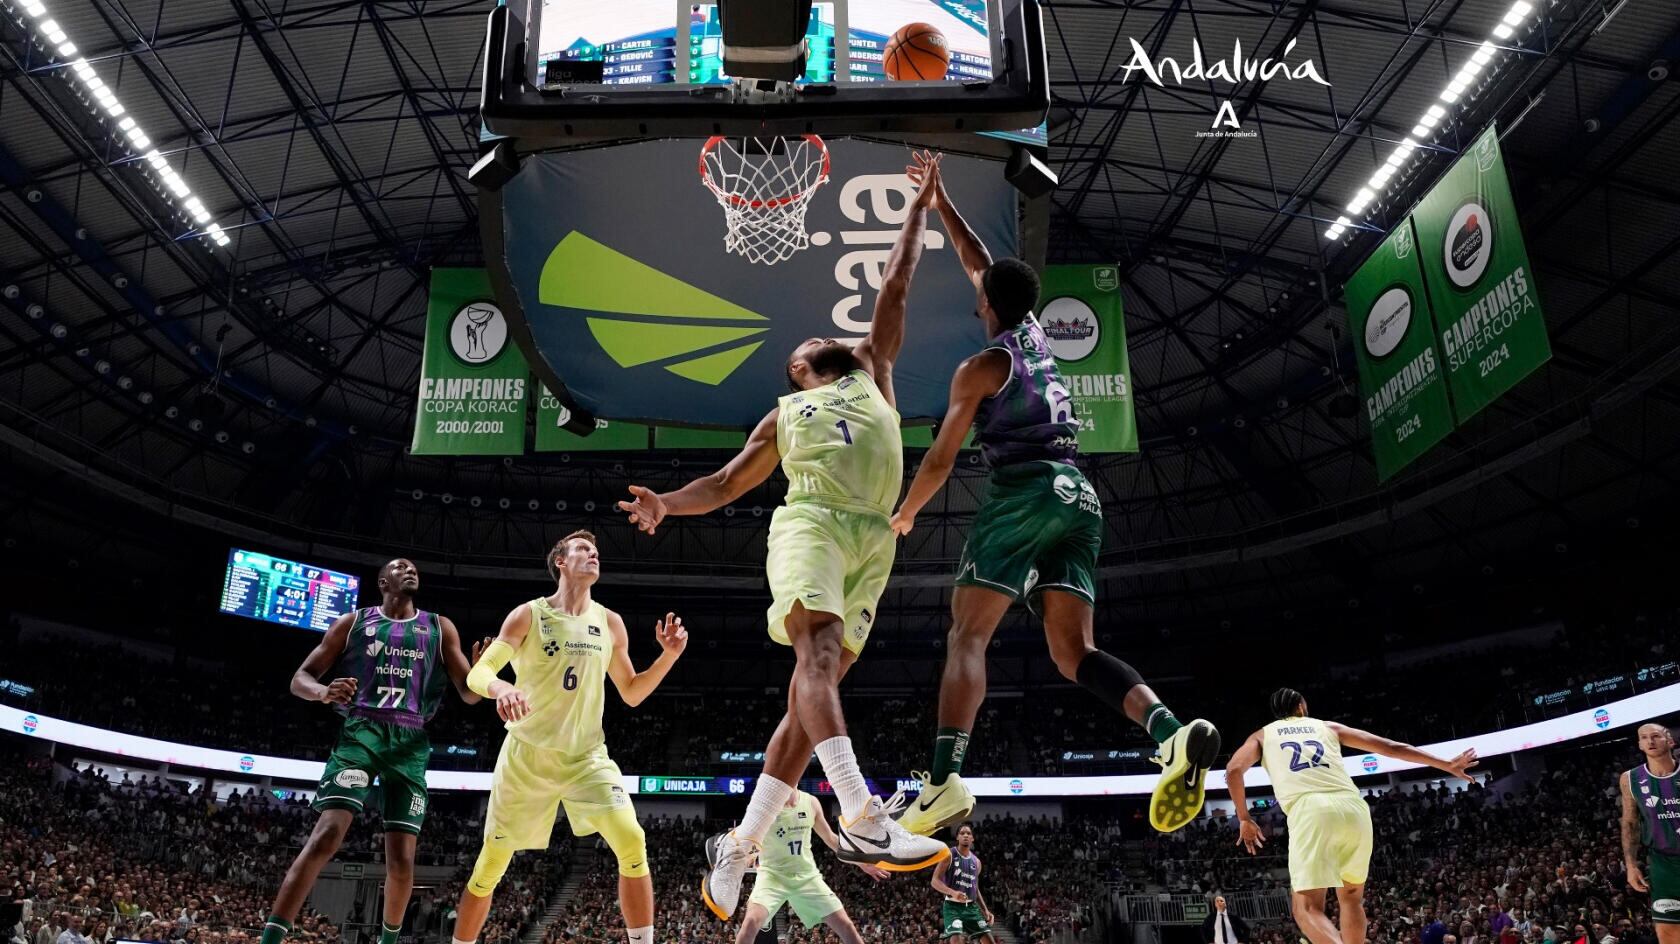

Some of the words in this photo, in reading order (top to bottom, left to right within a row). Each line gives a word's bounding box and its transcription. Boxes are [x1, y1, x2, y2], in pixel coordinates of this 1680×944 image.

[622, 40, 651, 50] CARTER
[603, 67, 612, 75] 33
[620, 65, 642, 73] TILLIE
[810, 174, 944, 347] caja
[1443, 266, 1528, 357] CAMPEONES
[1450, 294, 1535, 373] SUPERCOPA
[1479, 343, 1510, 378] 2024
[421, 378, 525, 400] CAMPEONES
[1063, 374, 1127, 396] PEONES
[1367, 346, 1436, 422] CAMPEONES
[425, 401, 465, 413] COPA
[468, 401, 518, 413] KORAC
[1074, 402, 1092, 414] CL
[436, 421, 504, 434] 2000/2001
[835, 420, 853, 445] 1
[1078, 419, 1095, 431] 24
[1395, 413, 1422, 443] 2024
[284, 588, 306, 601] 4:01
[384, 645, 424, 660] Unicaja
[563, 666, 577, 691] 6
[377, 686, 406, 708] 77
[1277, 725, 1316, 737] PARKER
[1118, 751, 1140, 759] Unicaja
[1280, 740, 1330, 773] 22
[663, 780, 706, 792] UNICAJA
[729, 779, 745, 793] 66
[896, 779, 924, 793] BARÇ
[1661, 797, 1680, 806] Unic
[787, 840, 802, 856] 17
